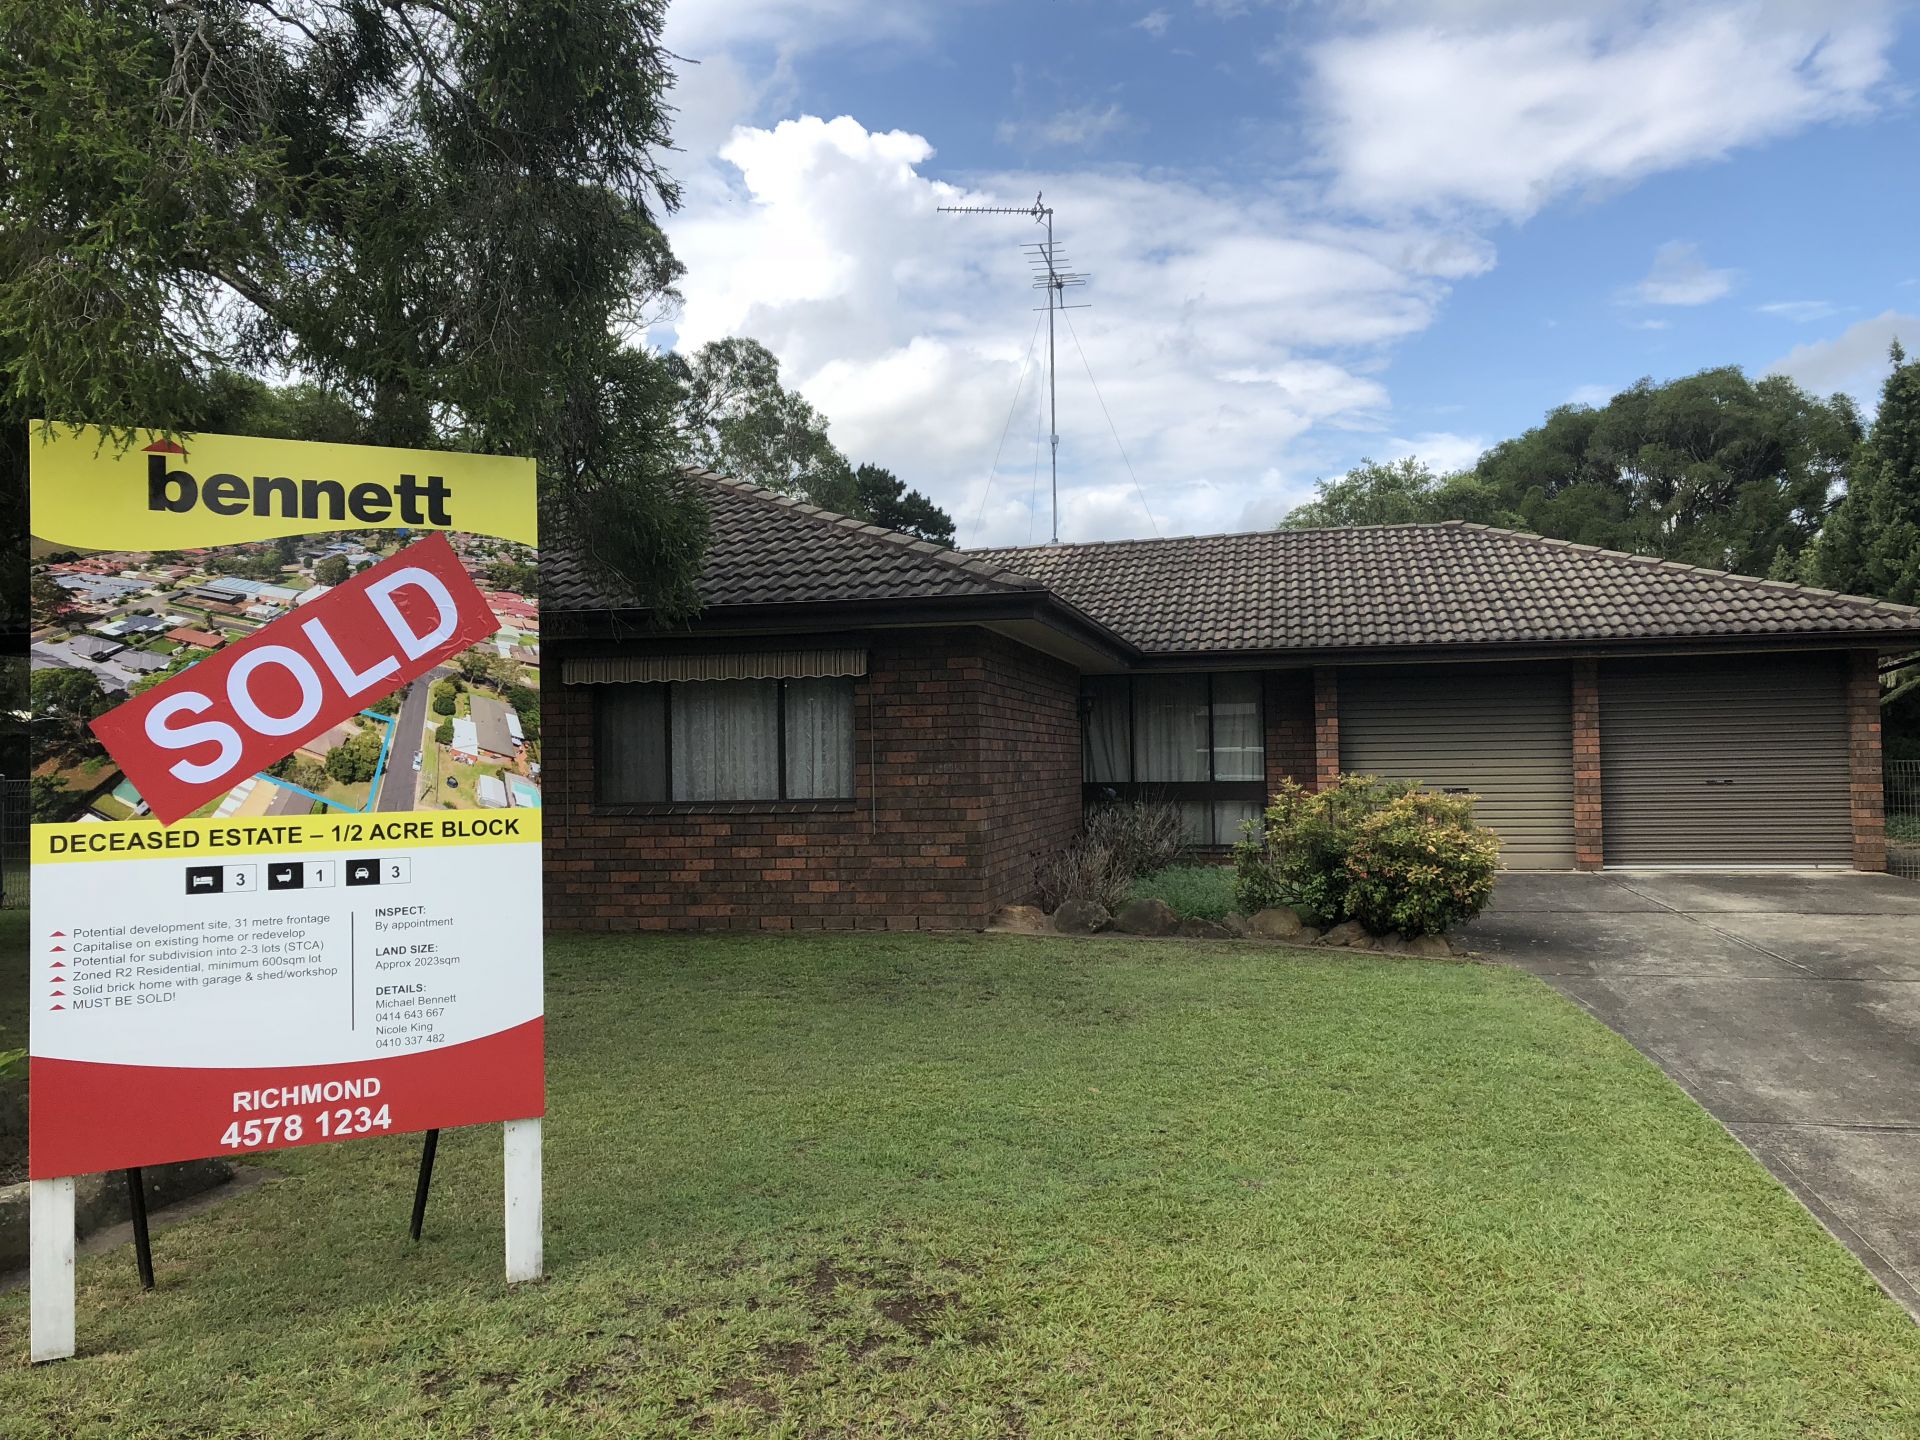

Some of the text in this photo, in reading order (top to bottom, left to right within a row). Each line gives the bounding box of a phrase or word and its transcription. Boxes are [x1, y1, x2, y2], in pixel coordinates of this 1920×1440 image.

[147, 454, 451, 526] bennett
[144, 567, 458, 785] SOLD
[50, 831, 200, 854] DECEASED
[209, 827, 303, 846] ESTATE
[331, 825, 363, 843] 1/2
[369, 822, 434, 840] ACRE
[442, 819, 520, 836] BLOCK
[316, 870, 323, 882] 1
[392, 866, 399, 878] 3
[236, 874, 245, 886] 3
[375, 906, 426, 917] INSPECT:
[73, 926, 126, 938] Potential
[130, 921, 204, 934] development
[235, 919, 248, 928] 31
[252, 917, 283, 927] metre
[287, 914, 330, 925] frontage
[376, 917, 453, 932] By appointment
[73, 941, 132, 953] Capitalise
[155, 935, 198, 948] existing
[202, 934, 234, 943] home
[252, 929, 305, 941] redevelop
[73, 940, 324, 966] Potential for subdivision into 2-3 lots (STCA)
[376, 944, 438, 956] LAND SIZE:
[73, 954, 322, 981] Zoned R2 Residential, minimum 600sqm lot
[376, 956, 460, 971] Approx 2023sqm
[73, 967, 338, 995] Solid brick home with garage & shed/workshop
[376, 984, 426, 995] DETAILS:
[73, 992, 176, 1010] MUST BE SOLD!
[376, 994, 456, 1008] Michael Bennett
[376, 1008, 444, 1022] 0414 643 667
[376, 1023, 433, 1035] Nicole King
[376, 1034, 445, 1048] 0410 337 482
[233, 1077, 380, 1112] RICHMOND
[220, 1104, 392, 1148] 4578 1234
